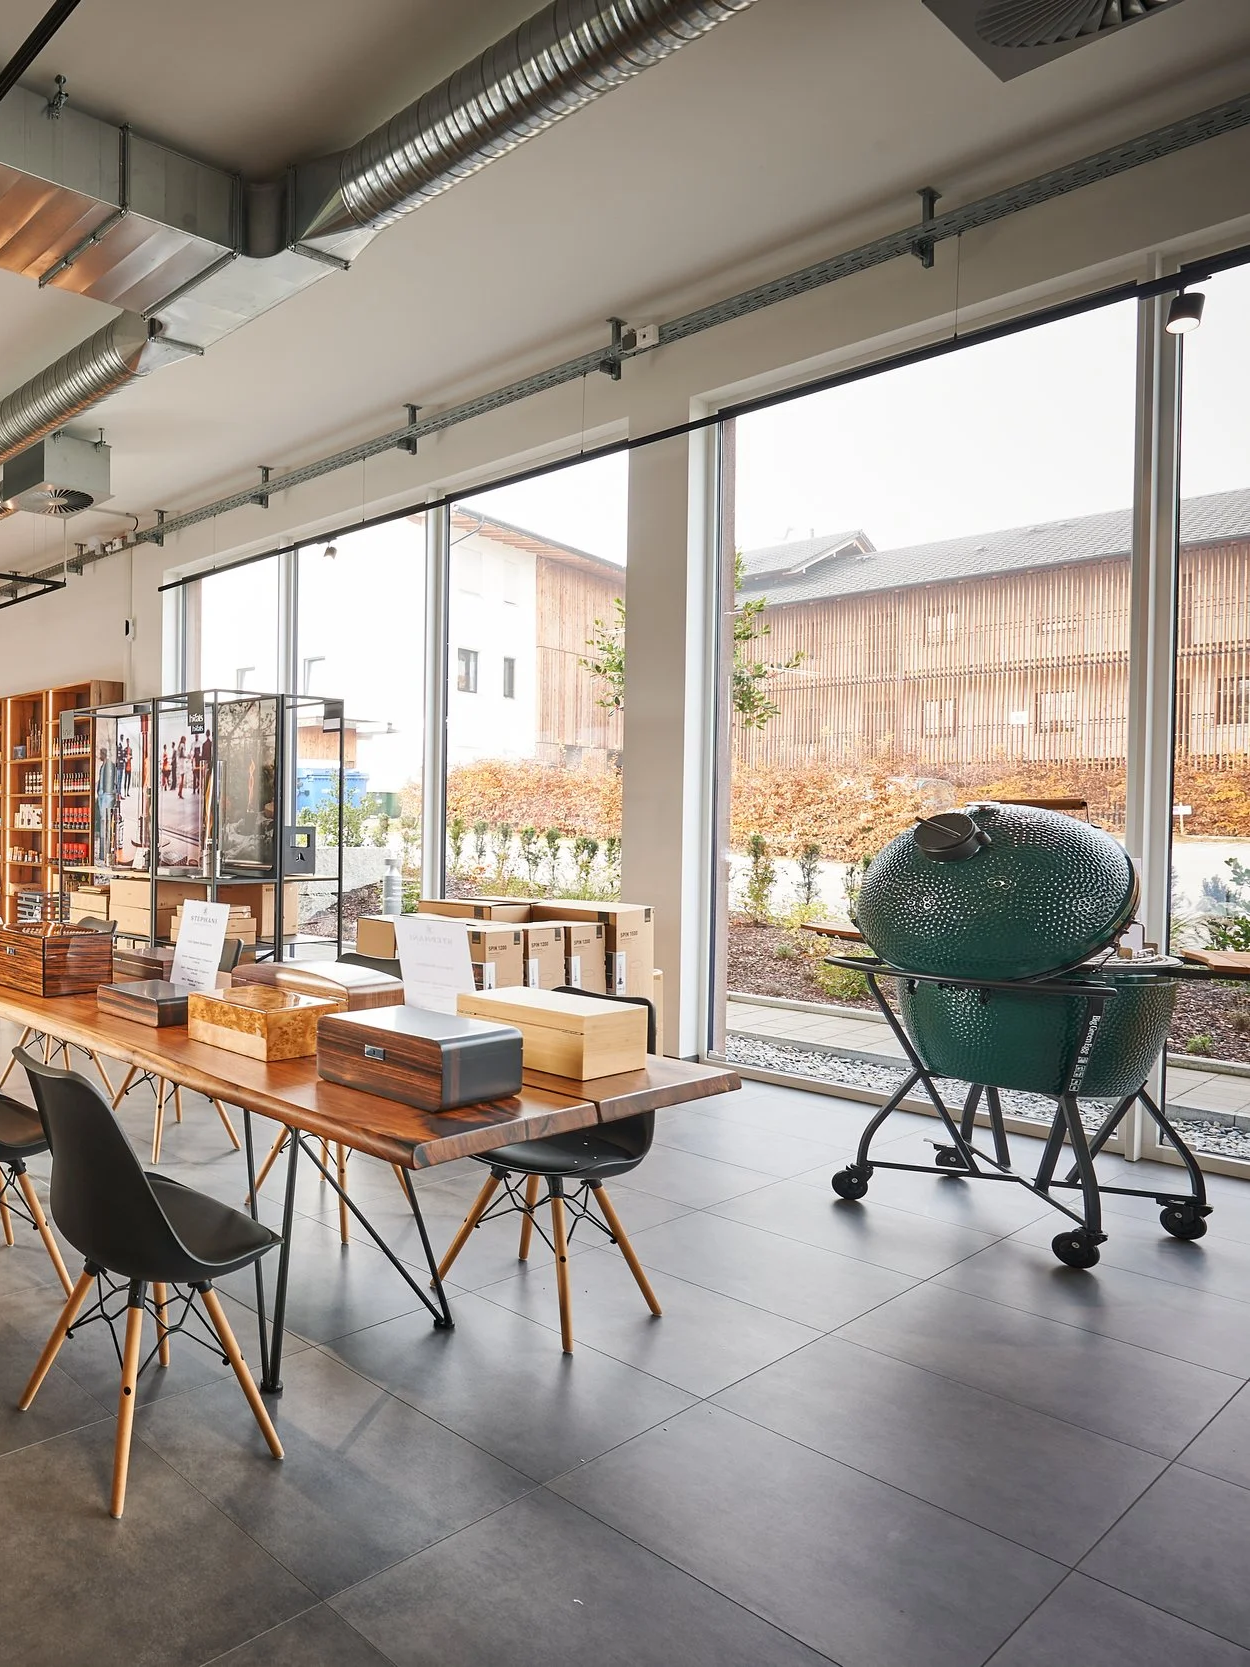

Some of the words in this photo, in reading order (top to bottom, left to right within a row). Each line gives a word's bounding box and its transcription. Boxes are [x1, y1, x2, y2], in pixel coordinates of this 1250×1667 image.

[190, 915, 218, 924] STEPHANI
[1089, 1016, 1101, 1026] Big
[1085, 1026, 1098, 1043] Green
[1080, 1043, 1092, 1054] Egg
